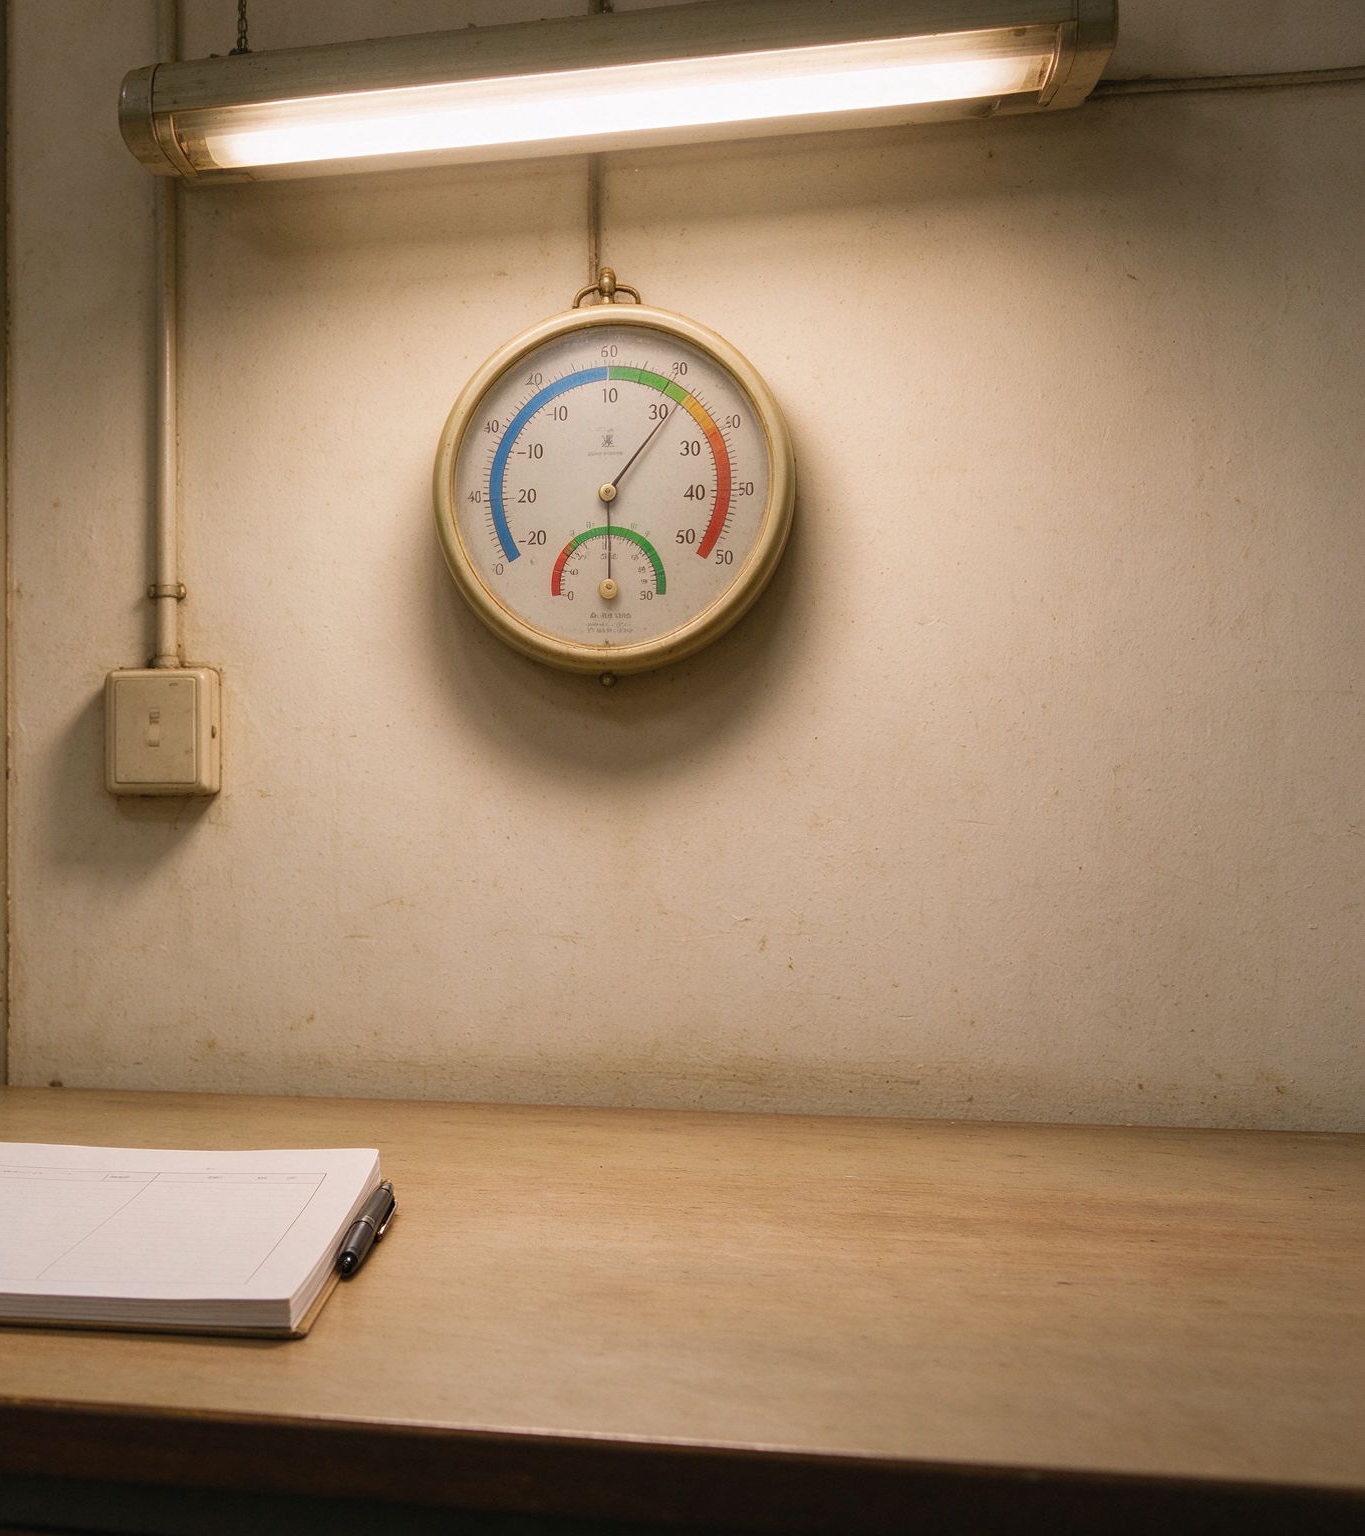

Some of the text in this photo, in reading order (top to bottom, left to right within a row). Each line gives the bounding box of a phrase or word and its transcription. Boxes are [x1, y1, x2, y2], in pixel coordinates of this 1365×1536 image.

[601, 344, 618, 358] 60
[602, 387, 618, 404] 10
[648, 403, 669, 420] 30
[679, 440, 701, 456] 30
[683, 484, 706, 500] 40
[675, 528, 696, 544] 50
[715, 549, 734, 565] 50
